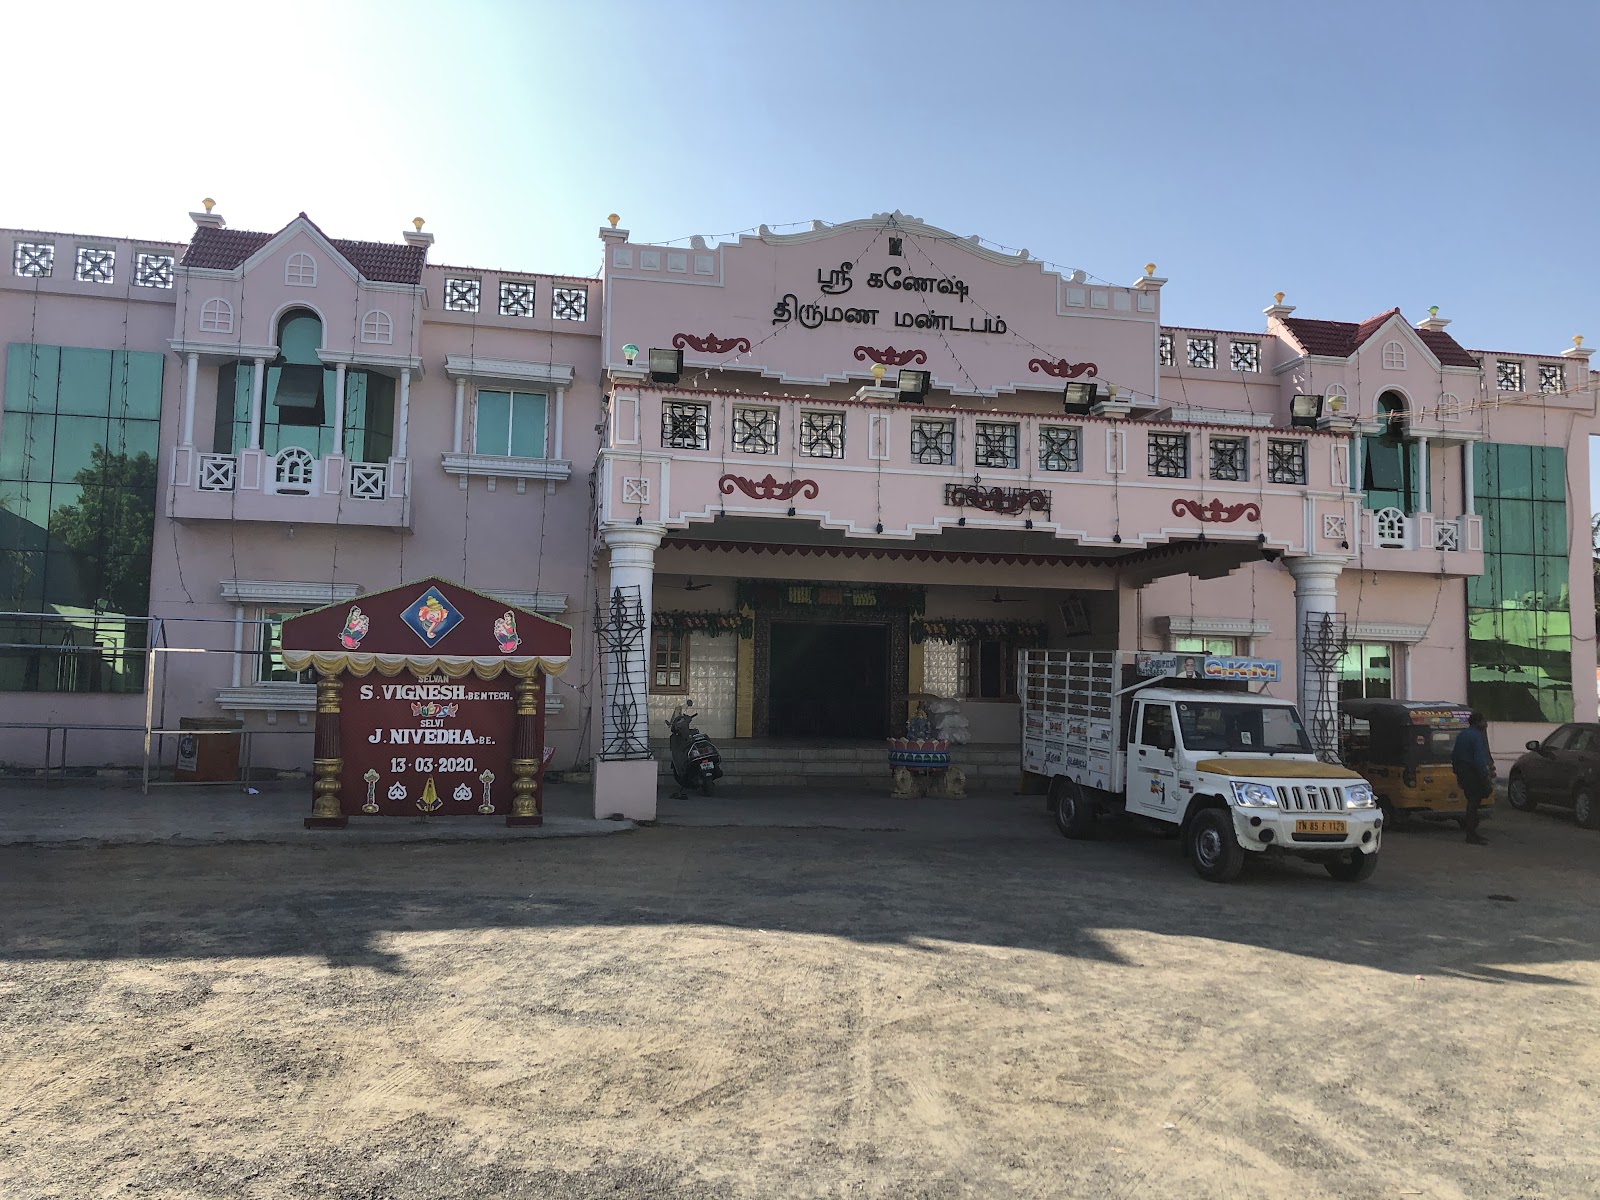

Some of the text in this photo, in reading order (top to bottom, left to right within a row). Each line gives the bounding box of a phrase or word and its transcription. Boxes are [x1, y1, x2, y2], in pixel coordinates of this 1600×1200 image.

[866, 265, 969, 303] கணேஷ்
[772, 293, 1007, 334] திருமண மண்டபம்
[420, 720, 444, 728] SELVI
[1299, 822, 1307, 831] TN
[1310, 822, 1319, 830] 85
